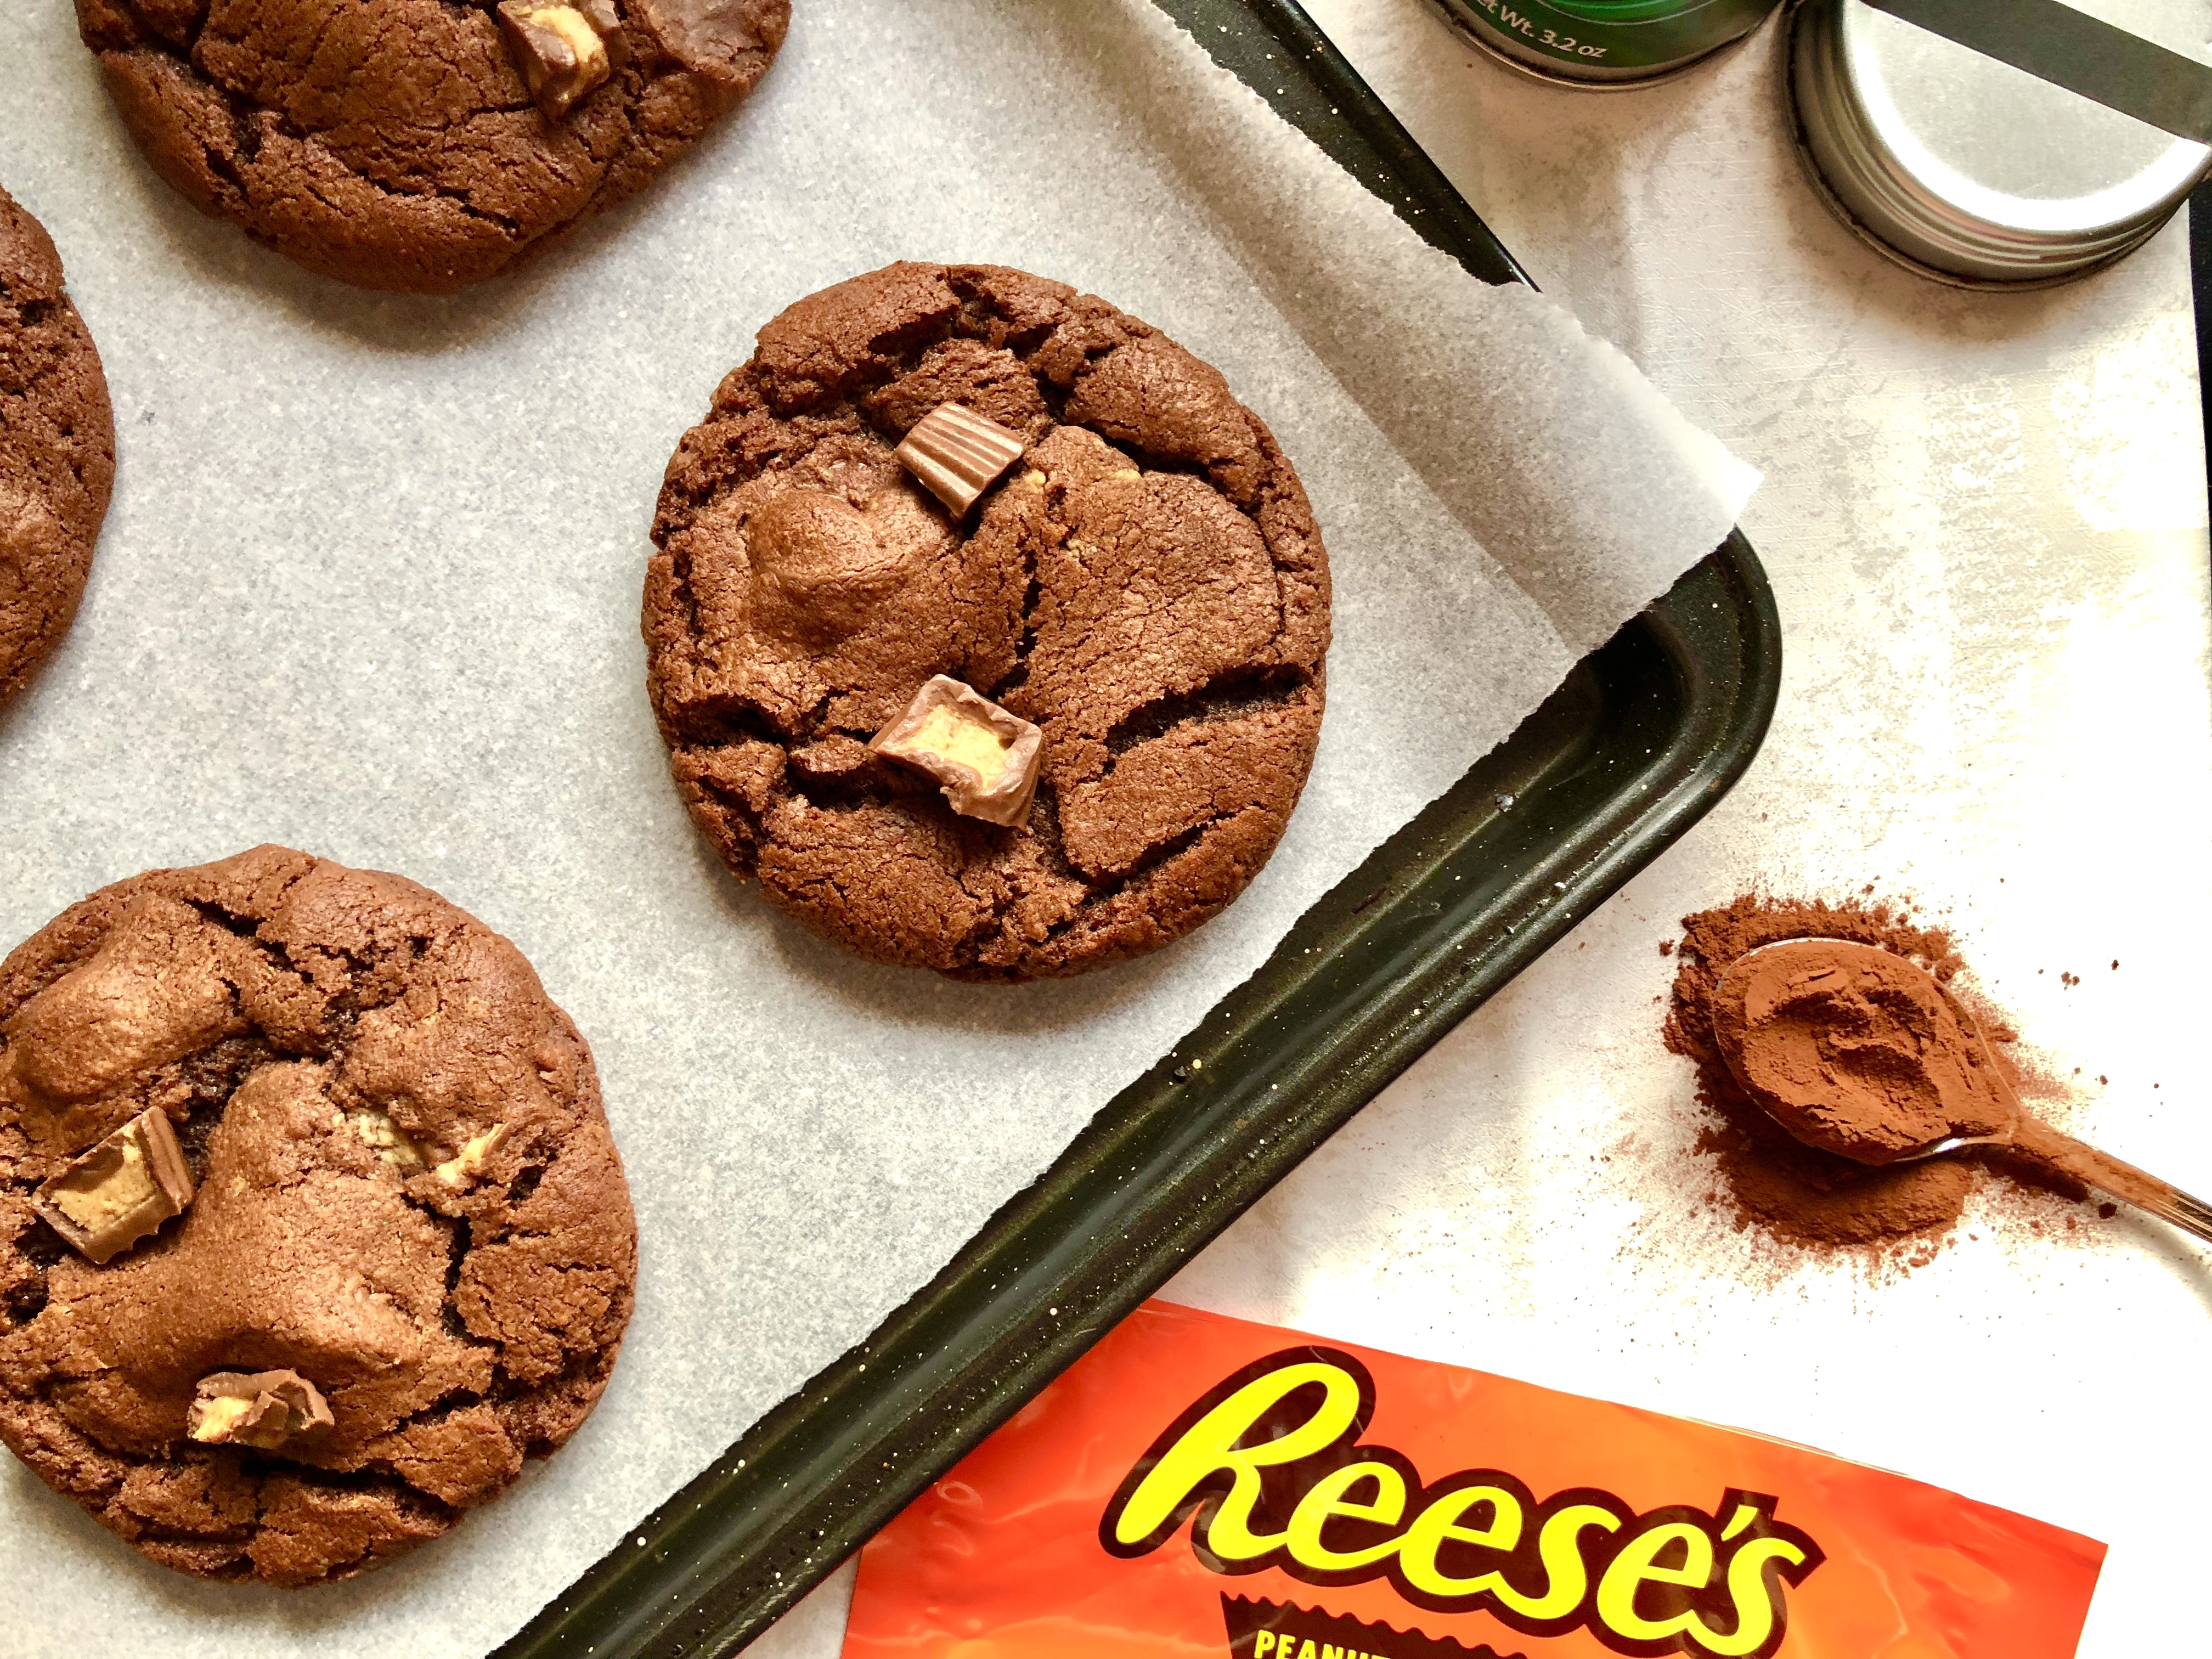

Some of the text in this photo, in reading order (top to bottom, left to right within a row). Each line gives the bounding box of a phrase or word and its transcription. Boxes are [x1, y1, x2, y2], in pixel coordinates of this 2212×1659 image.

[1500, 4, 1534, 37] Wt.
[1538, 29, 1577, 52] 3.2
[1577, 45, 1608, 58] oz
[1115, 1362, 1807, 1656] Reese's
[1254, 1629, 1391, 1659] PEAN
